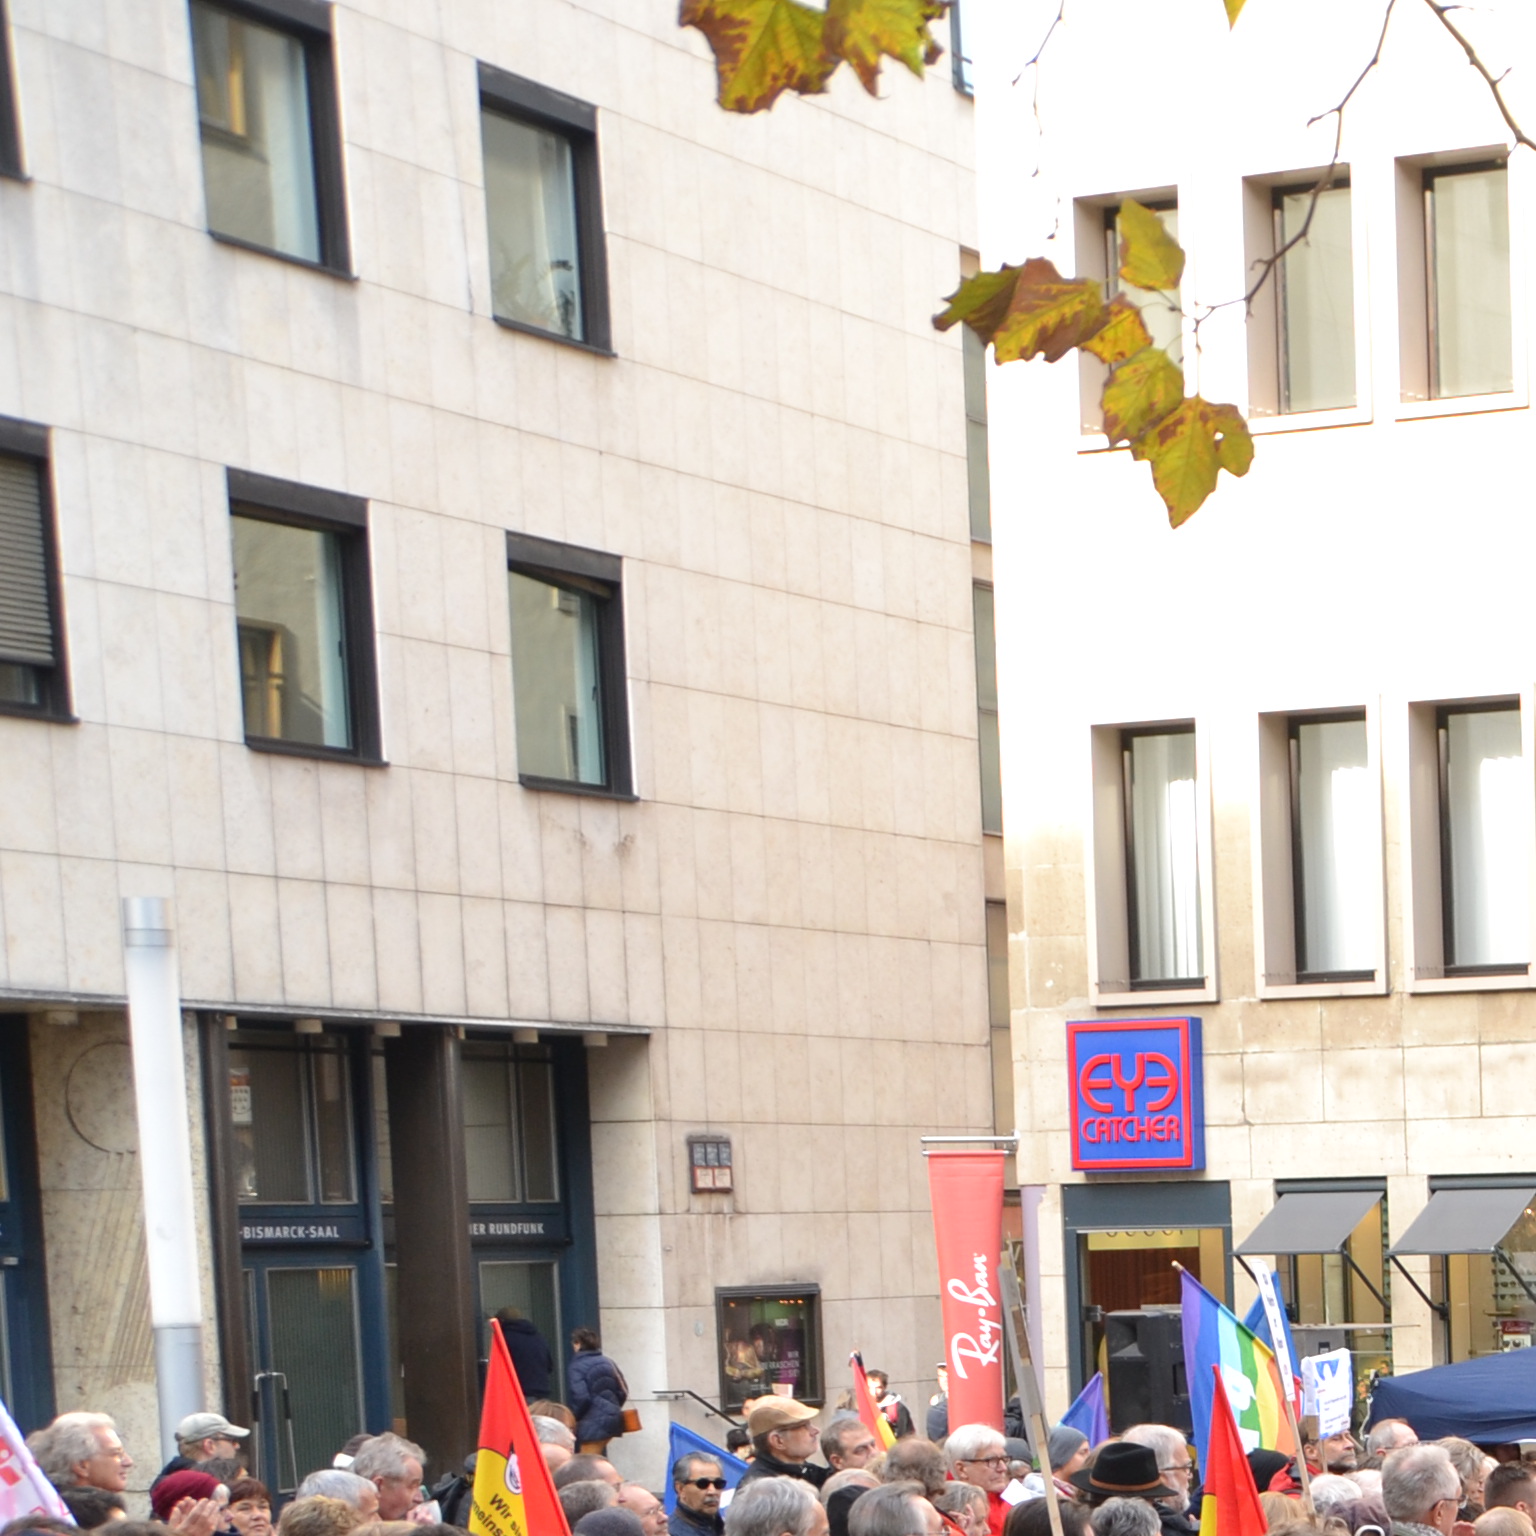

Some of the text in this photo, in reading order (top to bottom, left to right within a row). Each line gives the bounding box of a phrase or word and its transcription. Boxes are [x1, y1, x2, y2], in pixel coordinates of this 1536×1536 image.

[1080, 1053, 1178, 1112] EYE
[1082, 1115, 1180, 1143] CATCHER
[239, 1225, 340, 1240] -BISMARCK-SAAL
[489, 1222, 545, 1235] RUNDFUNK
[489, 1493, 512, 1520] Wir
